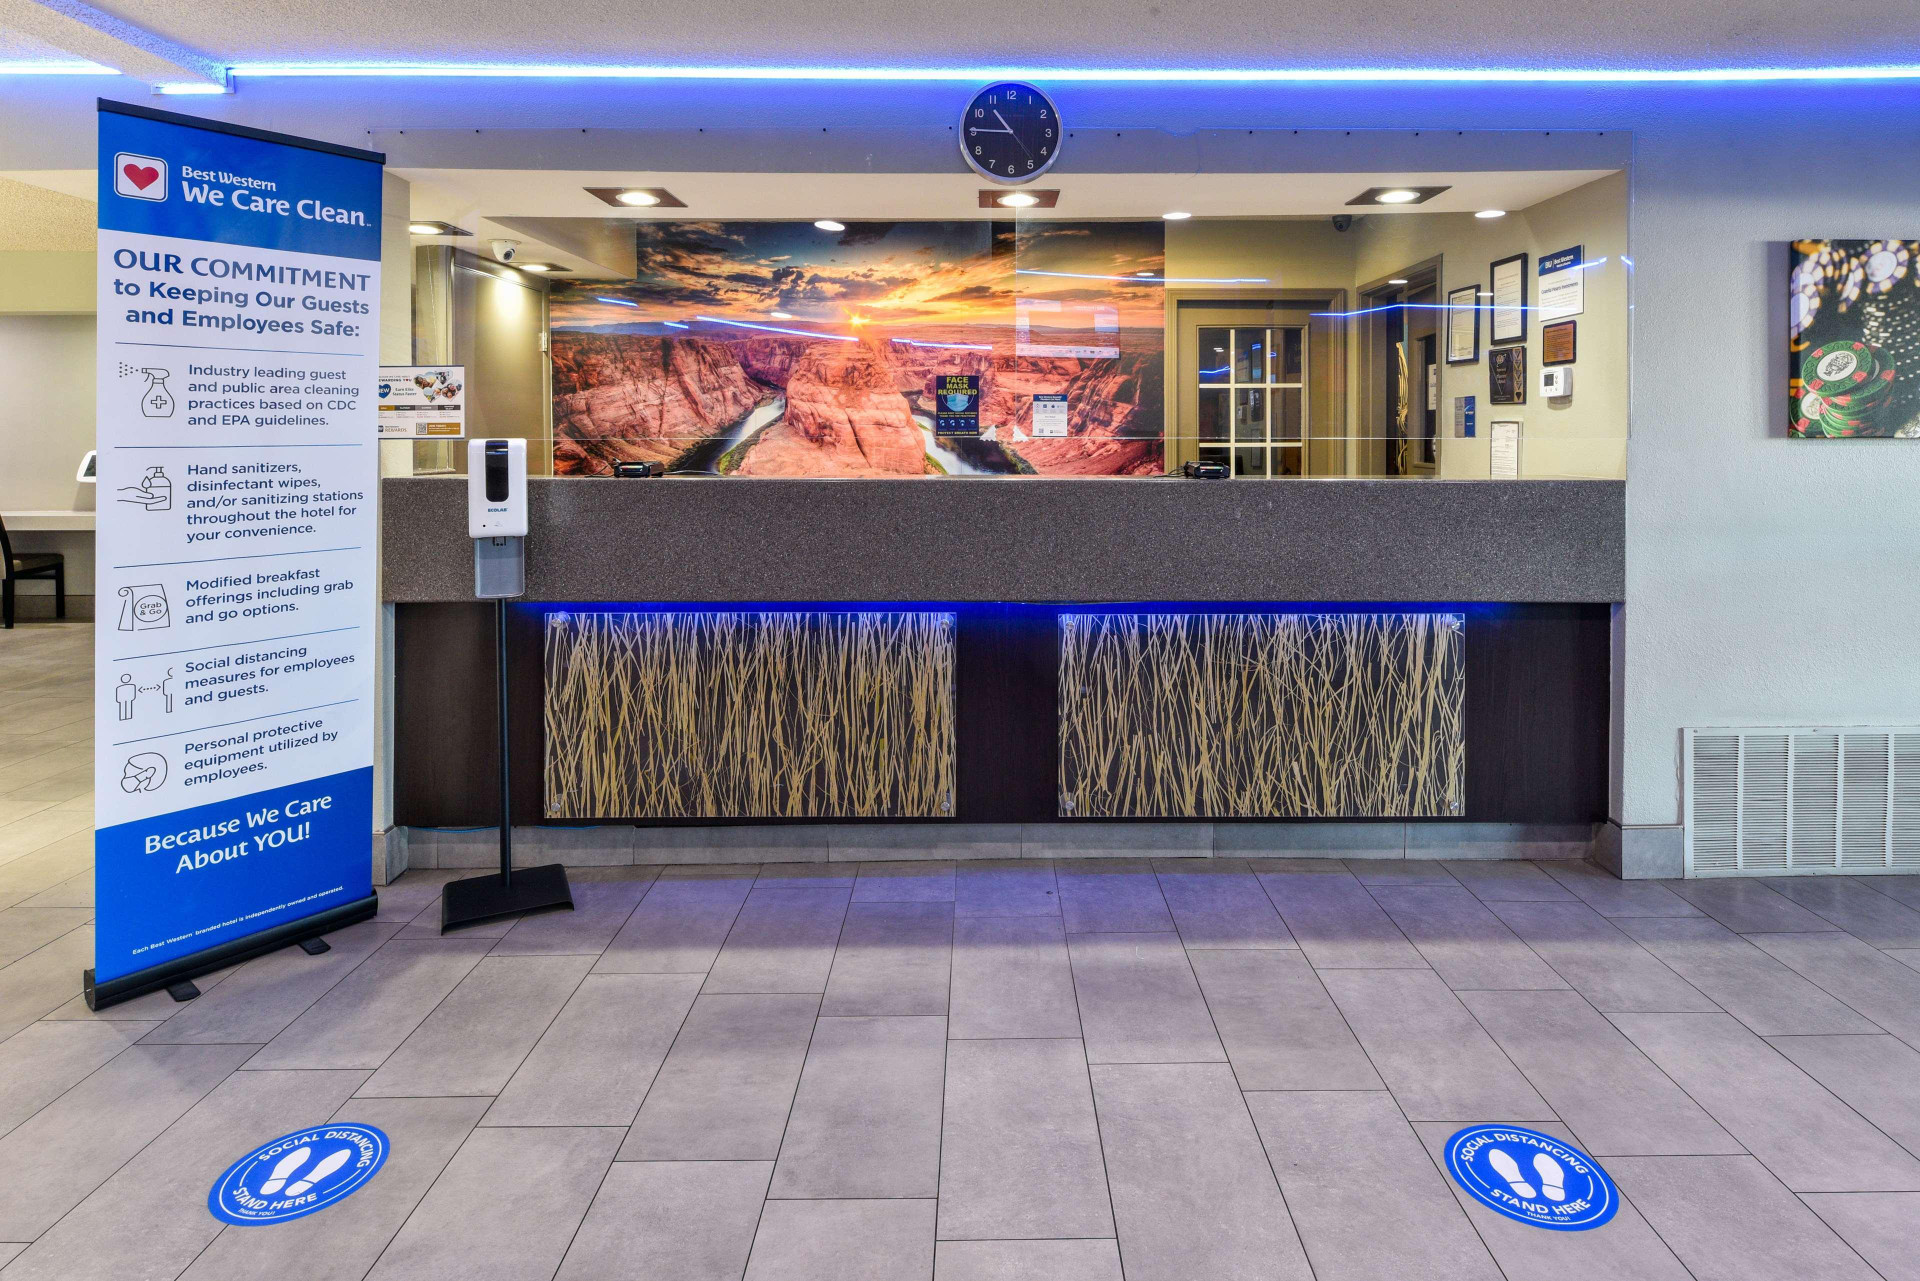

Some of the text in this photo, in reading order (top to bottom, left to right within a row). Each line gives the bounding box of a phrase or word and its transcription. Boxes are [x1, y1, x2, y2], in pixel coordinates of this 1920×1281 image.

[989, 95, 997, 104] 11
[1006, 90, 1016, 100] 12
[975, 109, 984, 118] 10
[1040, 110, 1047, 118] 2
[970, 127, 976, 136] 9
[1045, 128, 1052, 138] 3
[975, 146, 982, 155] 8
[1040, 146, 1047, 155] 4
[989, 160, 995, 168] 7
[1008, 165, 1014, 174] 6
[1027, 160, 1034, 169] 5
[182, 166, 276, 192] Best Western
[182, 181, 365, 226] We Care Clean
[114, 248, 371, 292] OUR COMMITMENT
[114, 279, 369, 314] to Keeping Our Guests
[126, 309, 360, 337] and Employees Safe:
[189, 364, 346, 382] Industry leading guest
[188, 382, 359, 397] and public area cleaning
[188, 398, 356, 411] practices based on CDC
[188, 414, 329, 427] and EPA guidelines.
[188, 463, 302, 475] Hand sanitizers,
[187, 477, 321, 492] disinfectant wipes,
[187, 490, 364, 509] and/or sanitizing stations
[187, 506, 356, 526] throughout the hotel for
[187, 524, 316, 543] your convenience.
[186, 568, 320, 591] Modified breakfast
[186, 580, 353, 608] offerings including grab
[186, 601, 298, 624] and go options.
[185, 647, 307, 674] Social distancing
[185, 655, 355, 690] measures for employees
[184, 687, 269, 706] and guests.
[184, 719, 323, 754] Personal protective
[184, 730, 338, 770] equipment utilized by
[184, 762, 267, 787] employees.
[145, 795, 332, 854] Because We Care
[176, 822, 310, 874] About YOU!
[132, 946, 148, 954] Each
[150, 941, 165, 949] Best
[195, 924, 221, 936] branded
[222, 919, 237, 927] hotel
[245, 903, 286, 920] independently
[287, 897, 306, 907] owned
[319, 886, 344, 898] operated.
[258, 1131, 374, 1168] SOCIAL DISTANCING
[1461, 1133, 1589, 1174] SOCIAL DISTANCING
[232, 1187, 318, 1210] STAND HERE
[1490, 1189, 1591, 1215] STAND HERE
[1527, 1211, 1552, 1220] THANK
